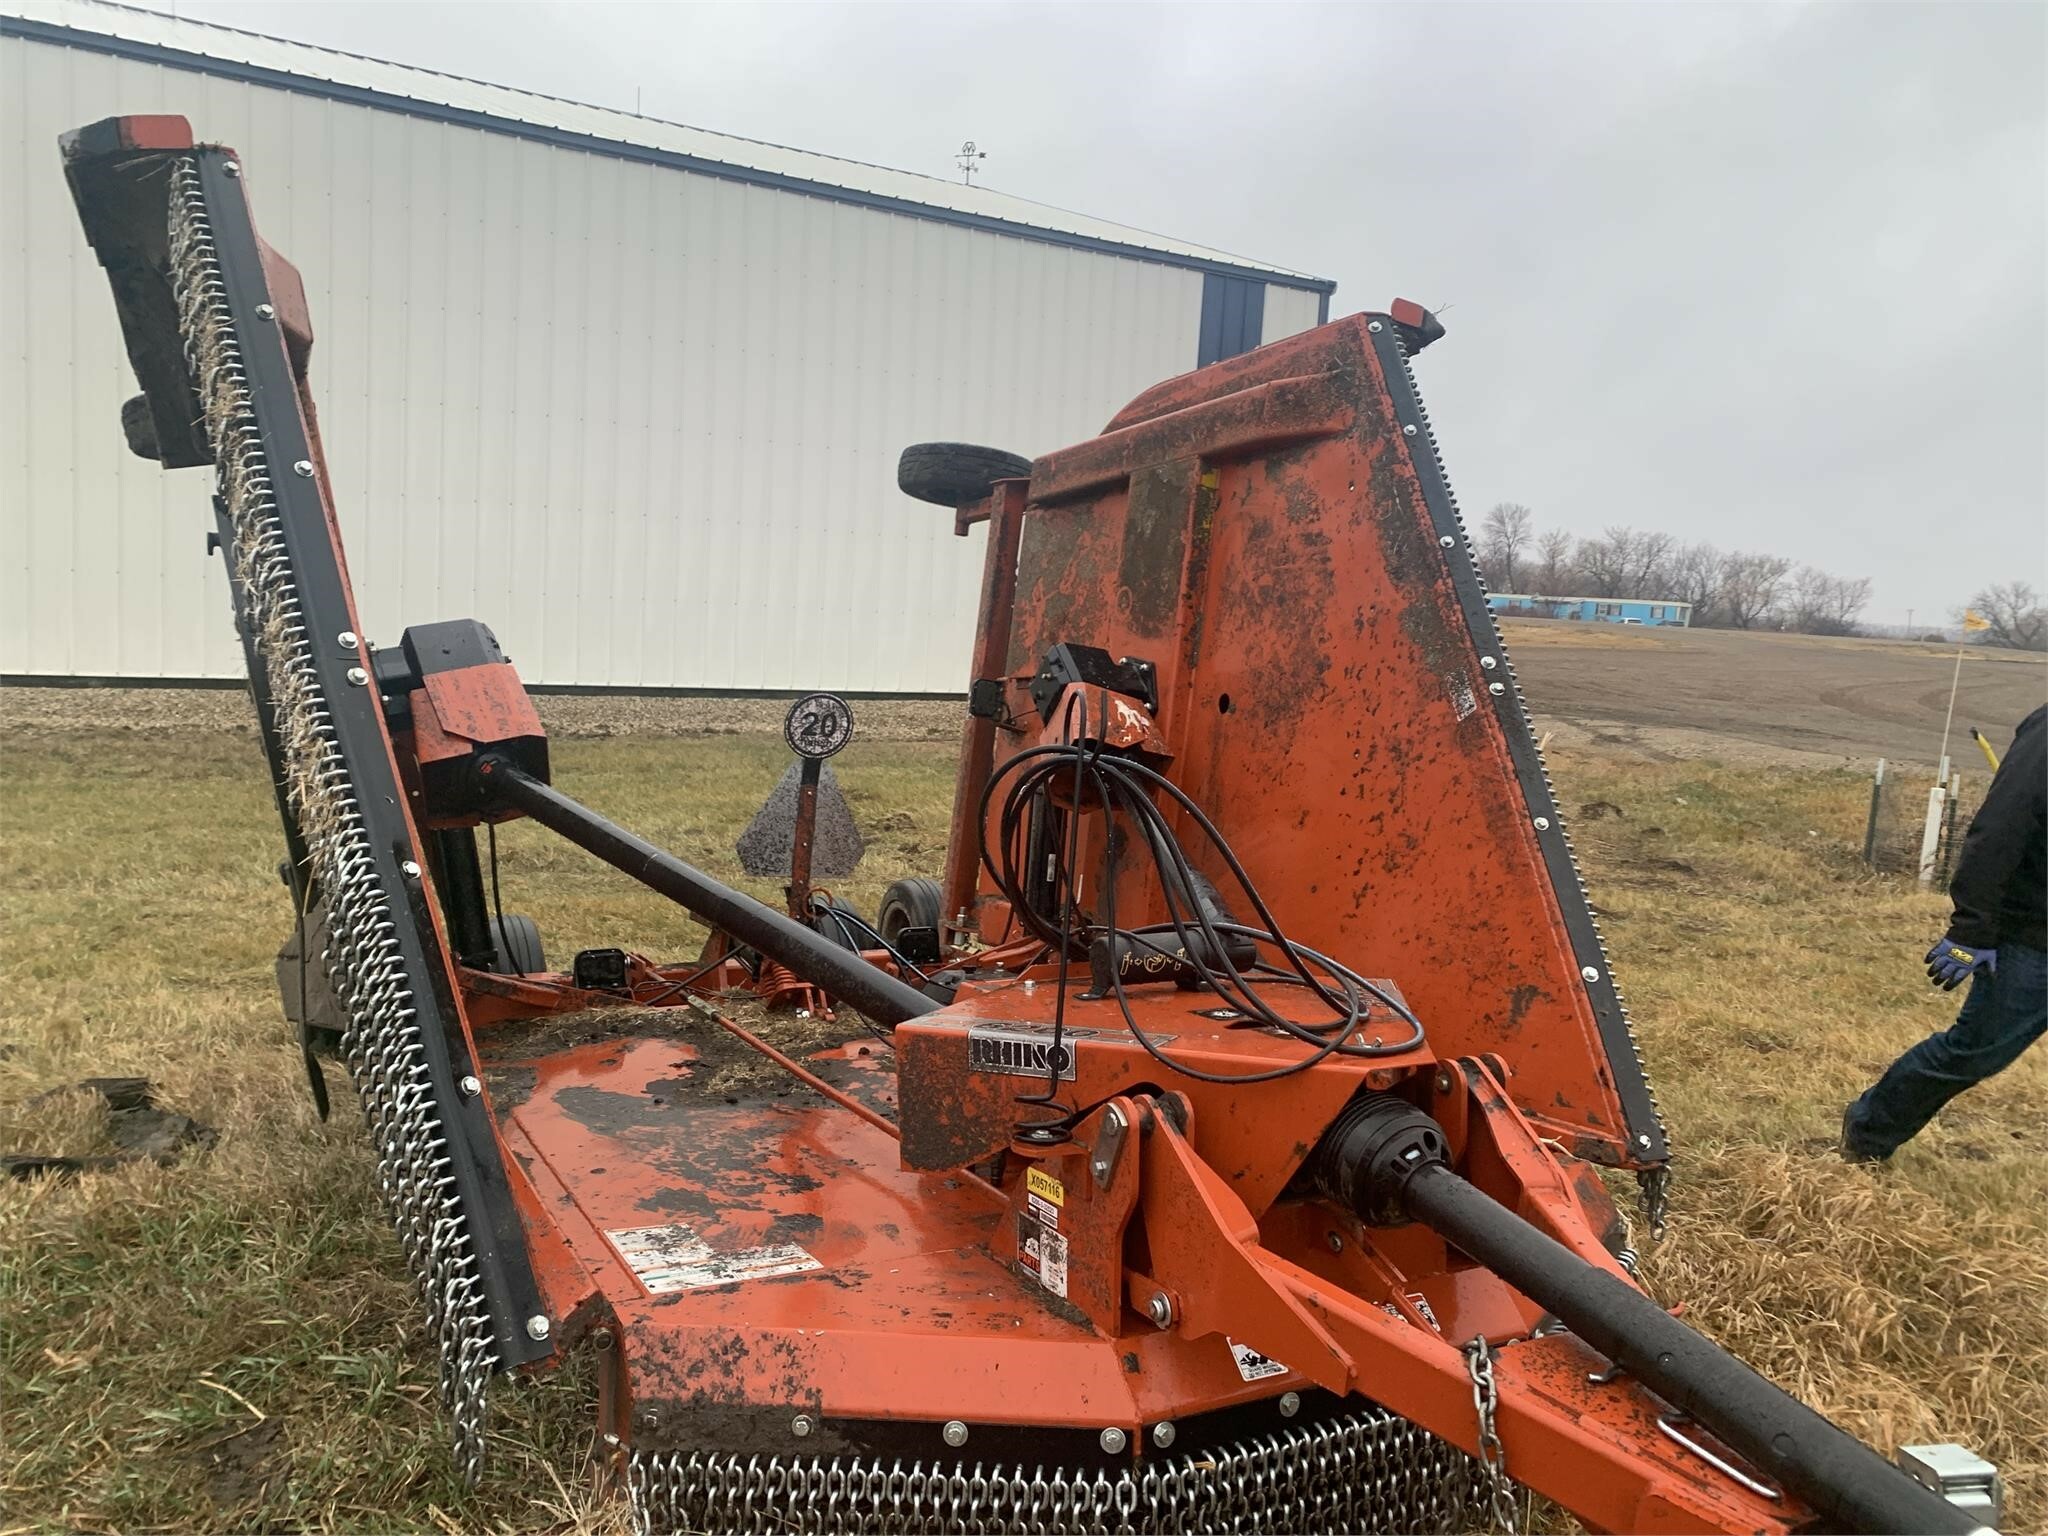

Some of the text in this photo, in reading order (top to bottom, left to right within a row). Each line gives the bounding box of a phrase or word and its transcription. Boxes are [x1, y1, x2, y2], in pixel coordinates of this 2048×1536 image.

[800, 712, 837, 737] 20
[970, 1038, 1072, 1073] RHINO
[1030, 1173, 1060, 1199] X057116
[1019, 1250, 1040, 1272] PARTS
